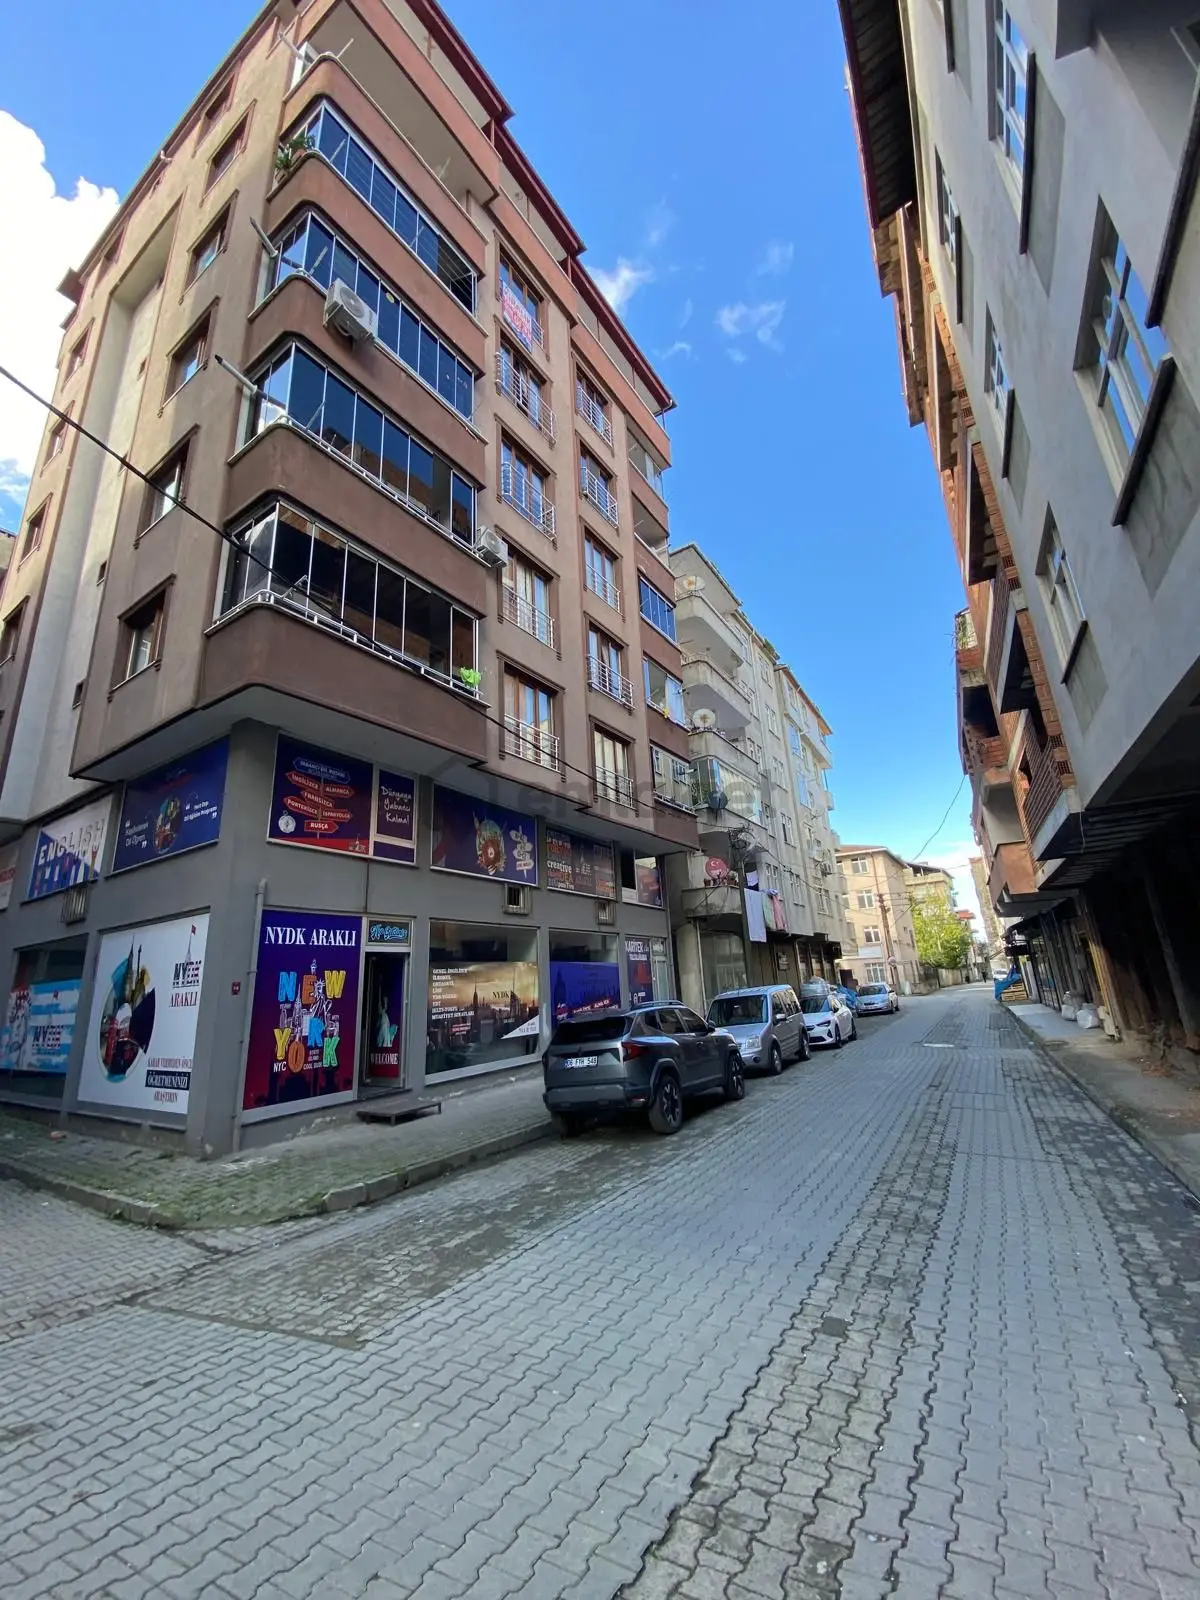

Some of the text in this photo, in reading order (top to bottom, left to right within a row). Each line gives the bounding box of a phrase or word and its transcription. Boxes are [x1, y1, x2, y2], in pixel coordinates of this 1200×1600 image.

[325, 786, 349, 796] ALMANCA
[304, 791, 333, 808] FRANSIZCA
[310, 822, 328, 830] RUSÇA
[547, 860, 573, 874] creative
[265, 926, 307, 945] NYDK
[309, 929, 356, 947] ARAKLI
[278, 970, 346, 1005] NEW
[169, 991, 198, 1008] ARAKLI
[274, 1017, 340, 1073] YORK
[370, 1053, 399, 1065] WELCOME
[273, 1062, 287, 1073] NYC
